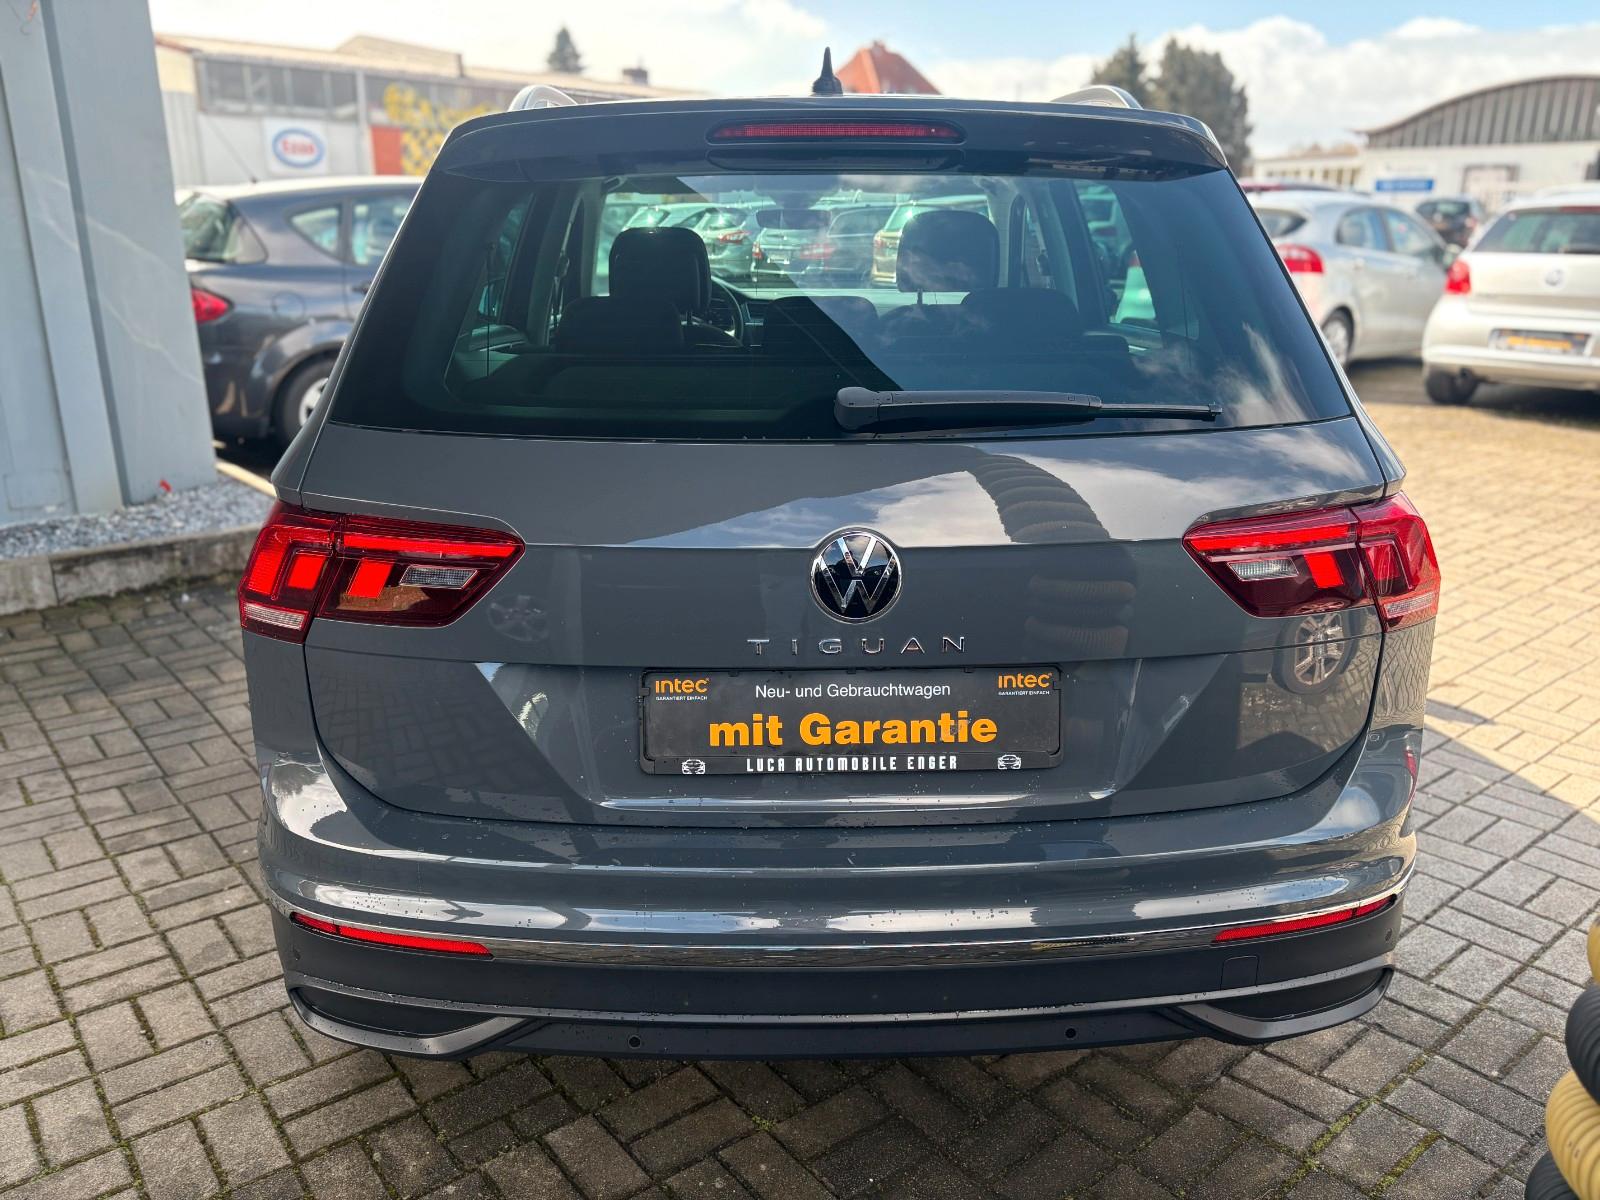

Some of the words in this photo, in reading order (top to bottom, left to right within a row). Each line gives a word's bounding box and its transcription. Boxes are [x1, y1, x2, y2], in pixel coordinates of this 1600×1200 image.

[746, 636, 965, 656] TIGUAN
[655, 678, 708, 694] intec
[997, 672, 1051, 689] intec
[755, 684, 791, 699] Neu-
[795, 683, 823, 698] und
[827, 682, 951, 700] Gebrauchtwagen
[709, 713, 783, 747] mit
[800, 710, 998, 746] Garantie
[746, 757, 785, 772] LUCA
[795, 756, 897, 771] AUTOMOBILE
[907, 755, 957, 770] ENGER
